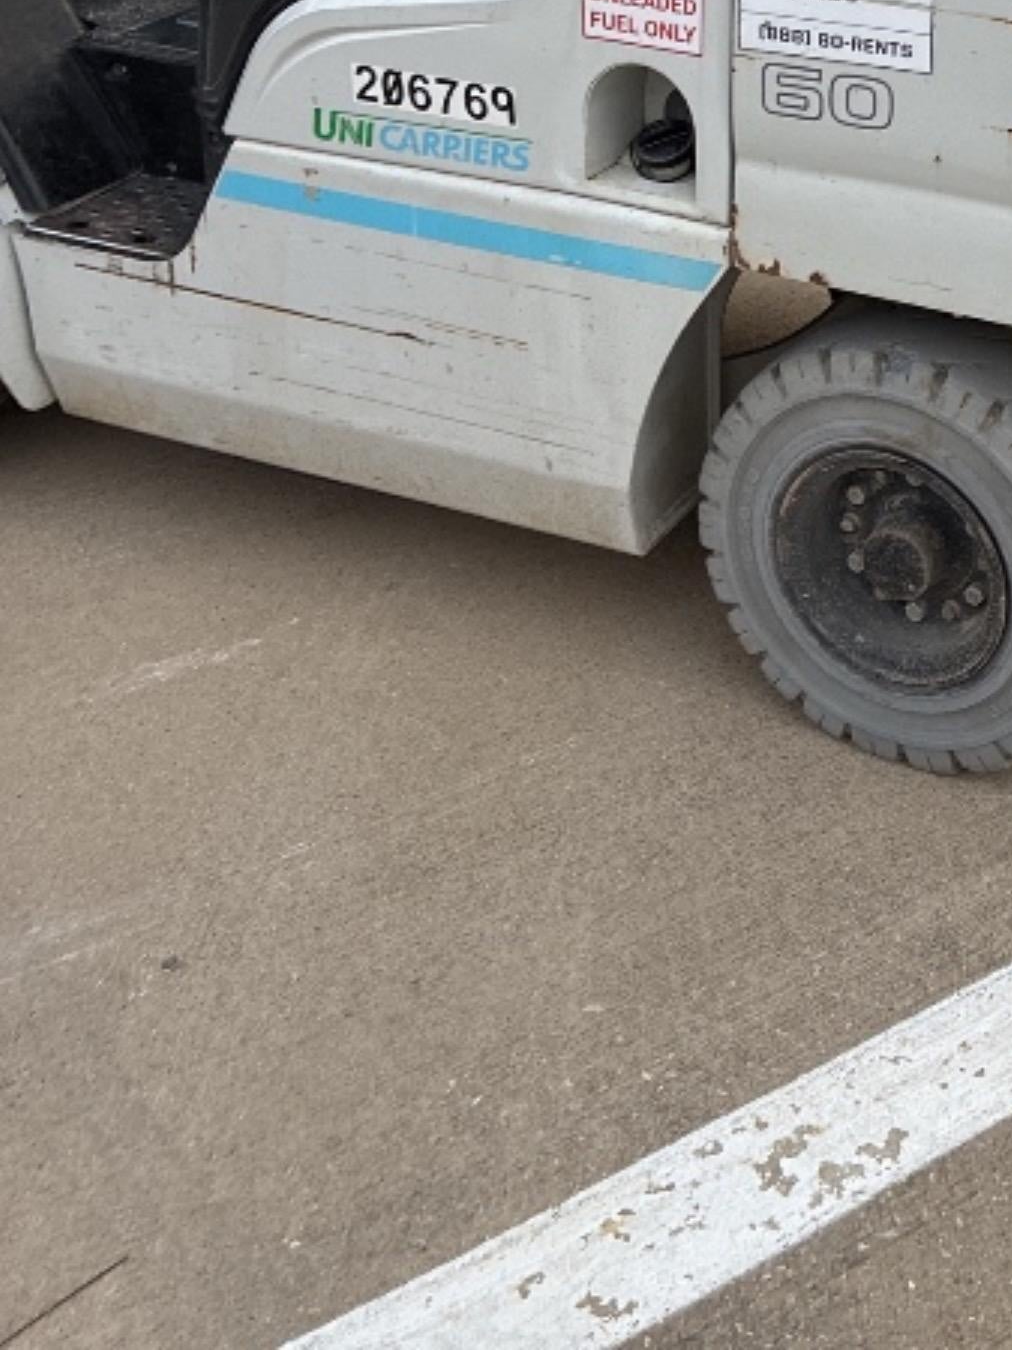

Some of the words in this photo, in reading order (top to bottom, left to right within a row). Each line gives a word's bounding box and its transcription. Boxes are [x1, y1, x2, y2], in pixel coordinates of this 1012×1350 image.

[590, 11, 638, 34] FUEL
[644, 20, 697, 44] ONLY
[355, 65, 517, 125] 206769
[761, 63, 894, 129] 60
